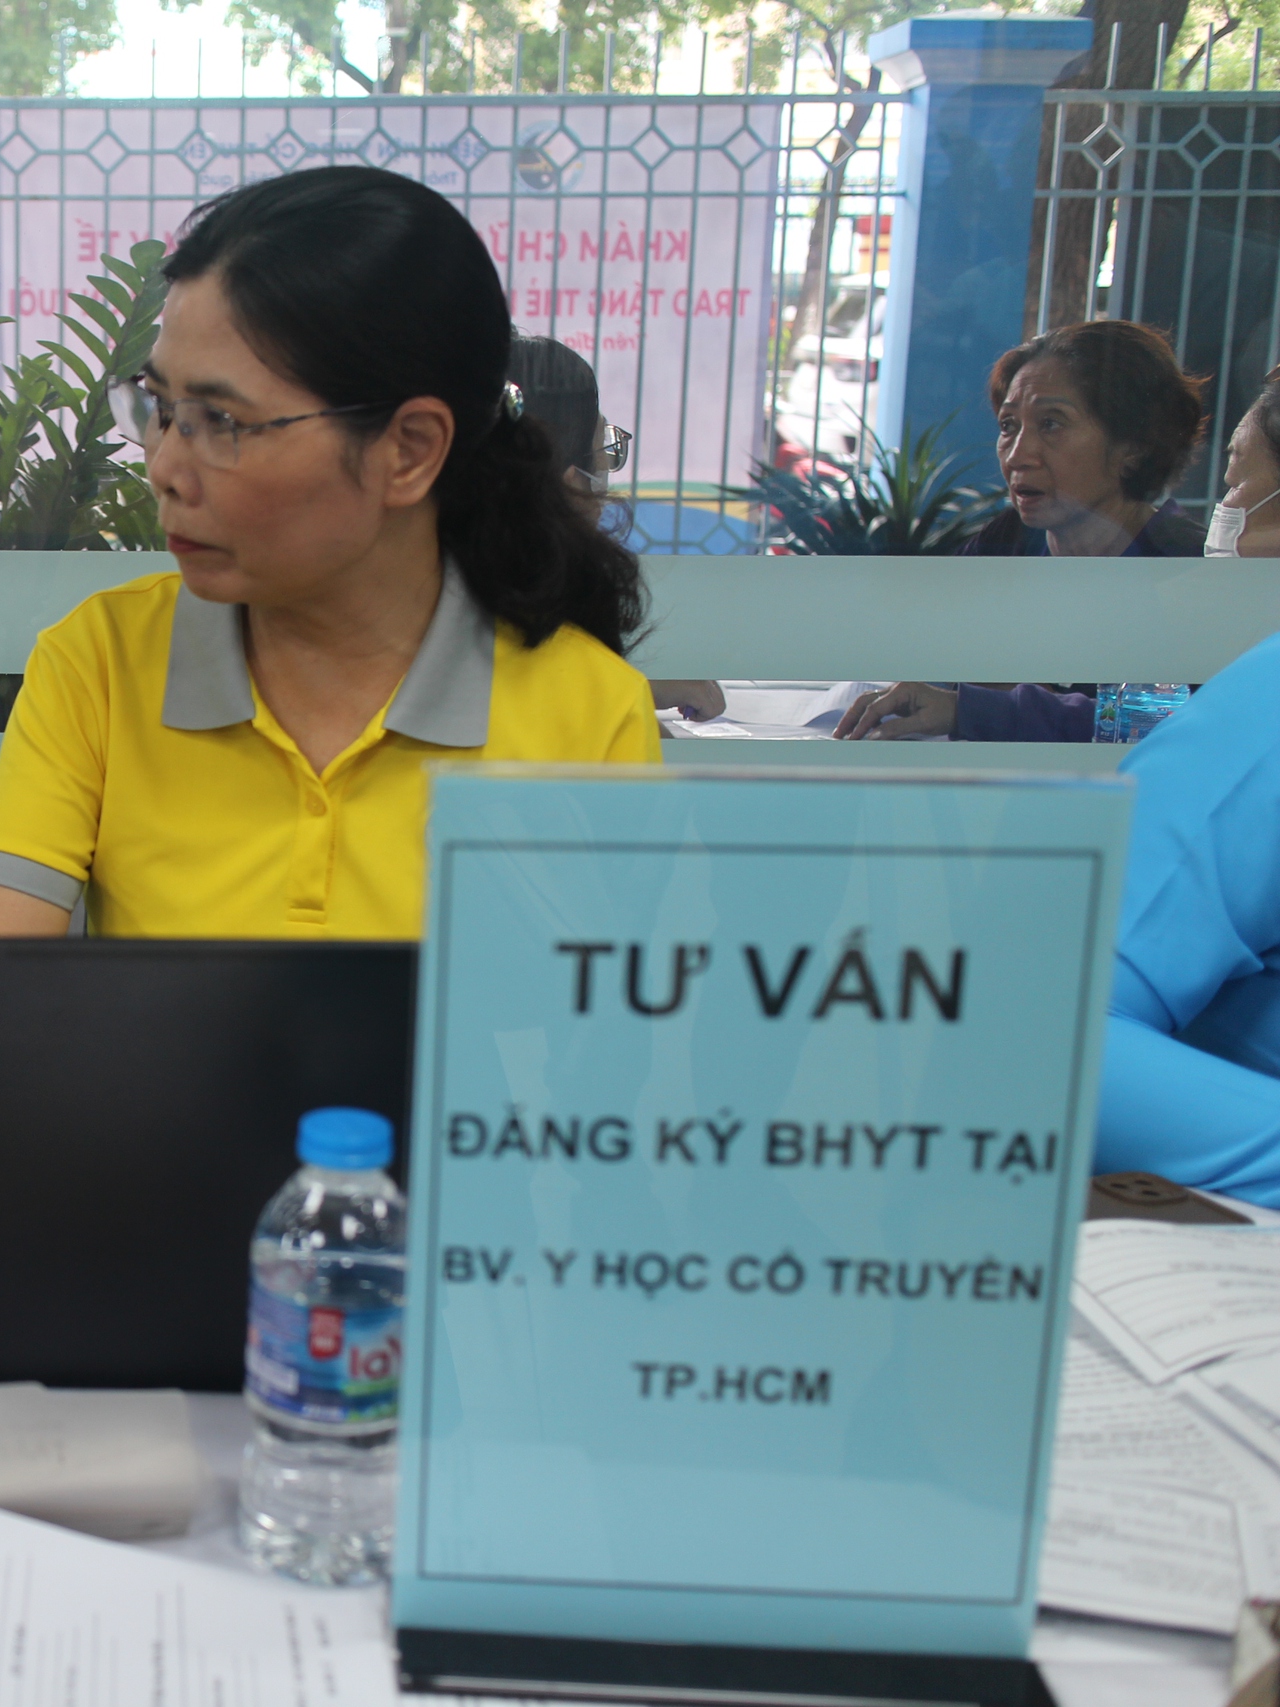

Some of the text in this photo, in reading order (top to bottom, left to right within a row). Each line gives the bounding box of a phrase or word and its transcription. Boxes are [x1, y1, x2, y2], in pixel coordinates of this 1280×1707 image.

[554, 926, 967, 1023] TƯ VẤN
[447, 1102, 632, 1163] ĐĂNG
[765, 1122, 944, 1170] BHYT
[963, 1130, 1058, 1185] TẠI
[443, 1246, 527, 1287] BV.
[542, 1249, 577, 1287] Y
[594, 1251, 709, 1300] HỌC
[631, 1362, 831, 1404] TP.HCM
